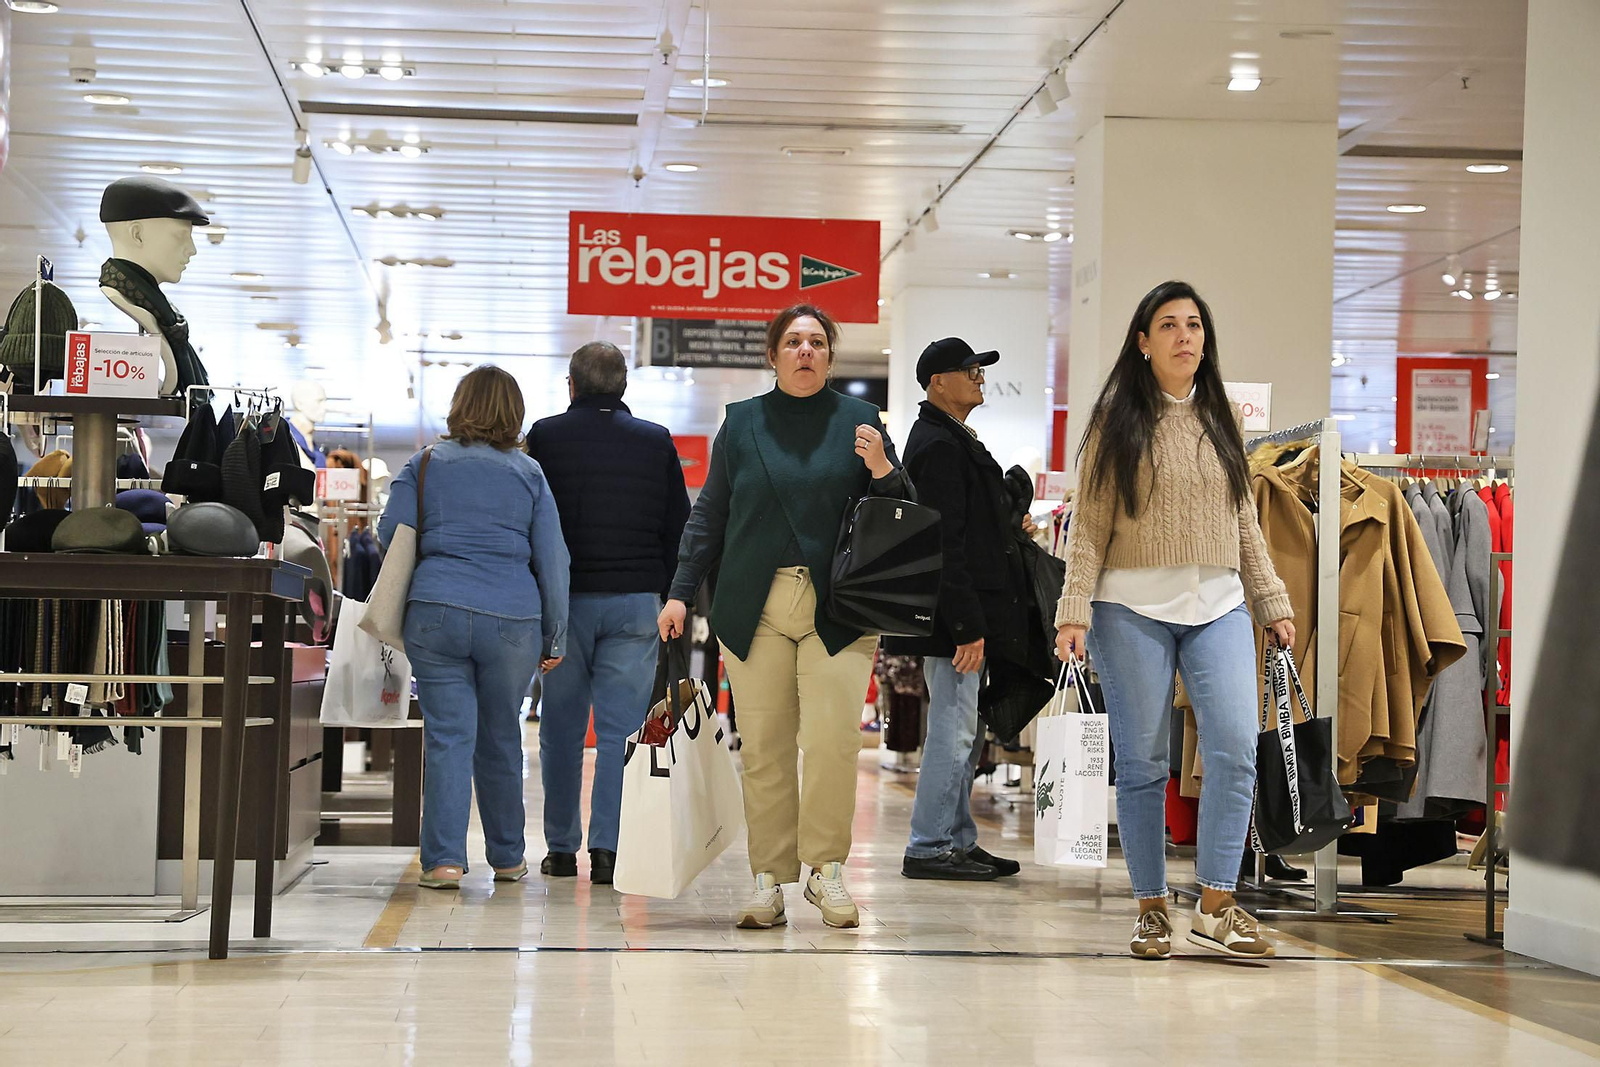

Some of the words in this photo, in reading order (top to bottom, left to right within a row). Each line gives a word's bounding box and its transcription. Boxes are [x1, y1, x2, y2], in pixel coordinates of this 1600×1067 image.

[578, 224, 621, 246] Las
[578, 235, 790, 299] rebajas
[652, 327, 670, 359] B
[73, 342, 87, 387] rebajas
[94, 359, 145, 380] -10%
[1279, 701, 1292, 740] BIMBA
[1284, 742, 1296, 782] BIMBA
